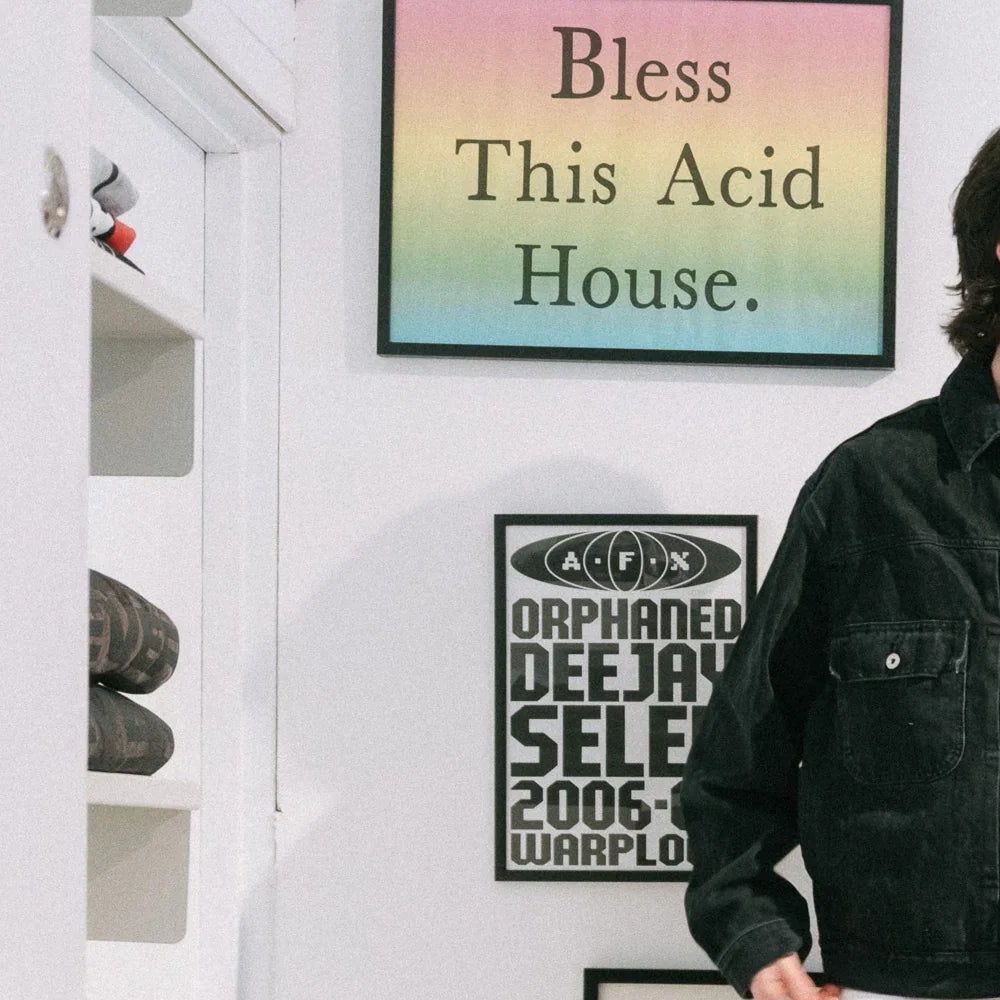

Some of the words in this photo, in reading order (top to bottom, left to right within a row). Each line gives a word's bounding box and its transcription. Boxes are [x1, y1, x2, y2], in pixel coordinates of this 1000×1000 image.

[551, 26, 731, 103] Bless
[455, 138, 617, 205] This
[656, 142, 824, 210] Acid
[513, 243, 759, 312] House.
[511, 597, 742, 640] ORPHANED
[510, 704, 708, 777] SELE
[510, 833, 692, 866] WARPLO
